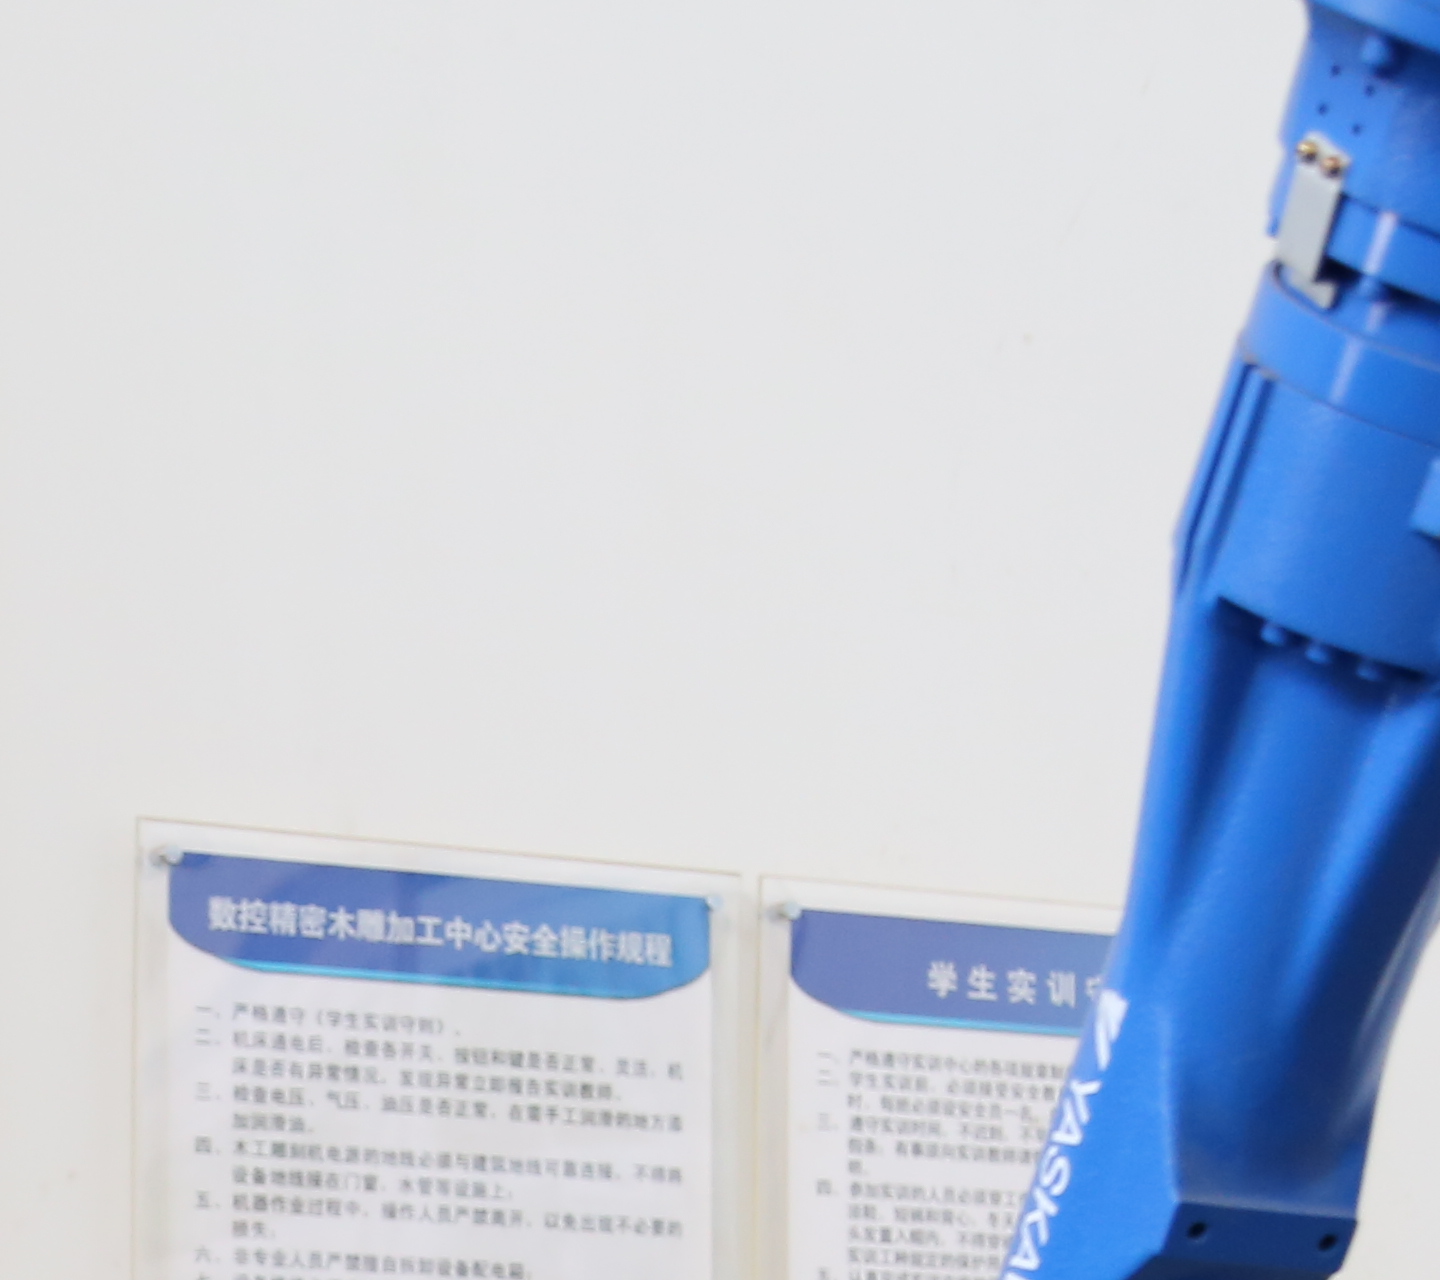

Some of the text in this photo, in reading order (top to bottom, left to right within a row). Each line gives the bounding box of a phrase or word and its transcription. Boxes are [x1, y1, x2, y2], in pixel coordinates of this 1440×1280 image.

[207, 896, 674, 967] 数控精密木雕加工中心安全操作规程
